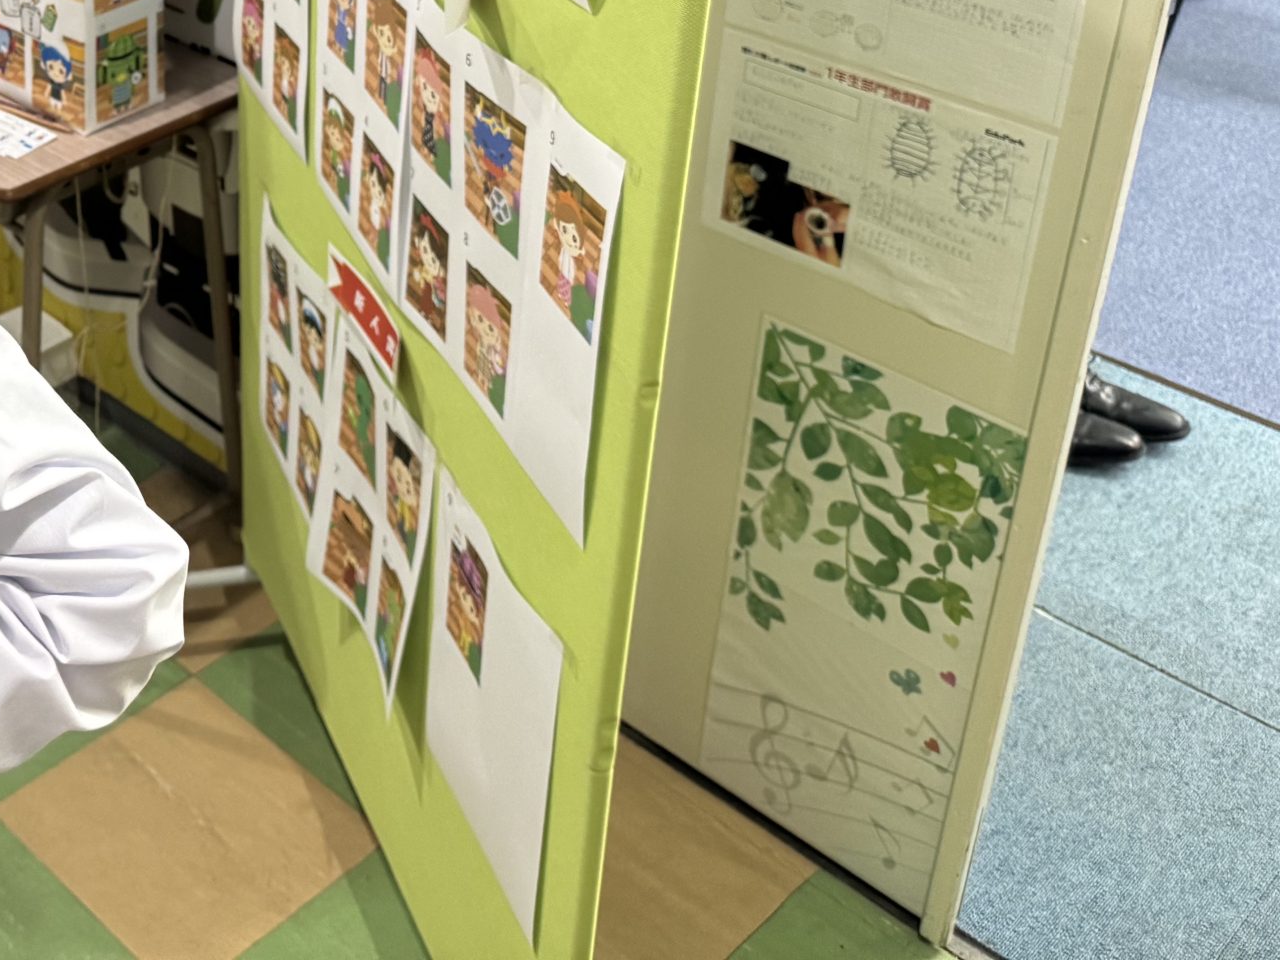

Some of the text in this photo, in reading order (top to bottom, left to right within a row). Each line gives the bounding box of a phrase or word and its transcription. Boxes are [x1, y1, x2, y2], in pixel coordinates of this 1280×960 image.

[465, 53, 472, 67] 6
[825, 67, 933, 112] 1年生部門敢闘賞
